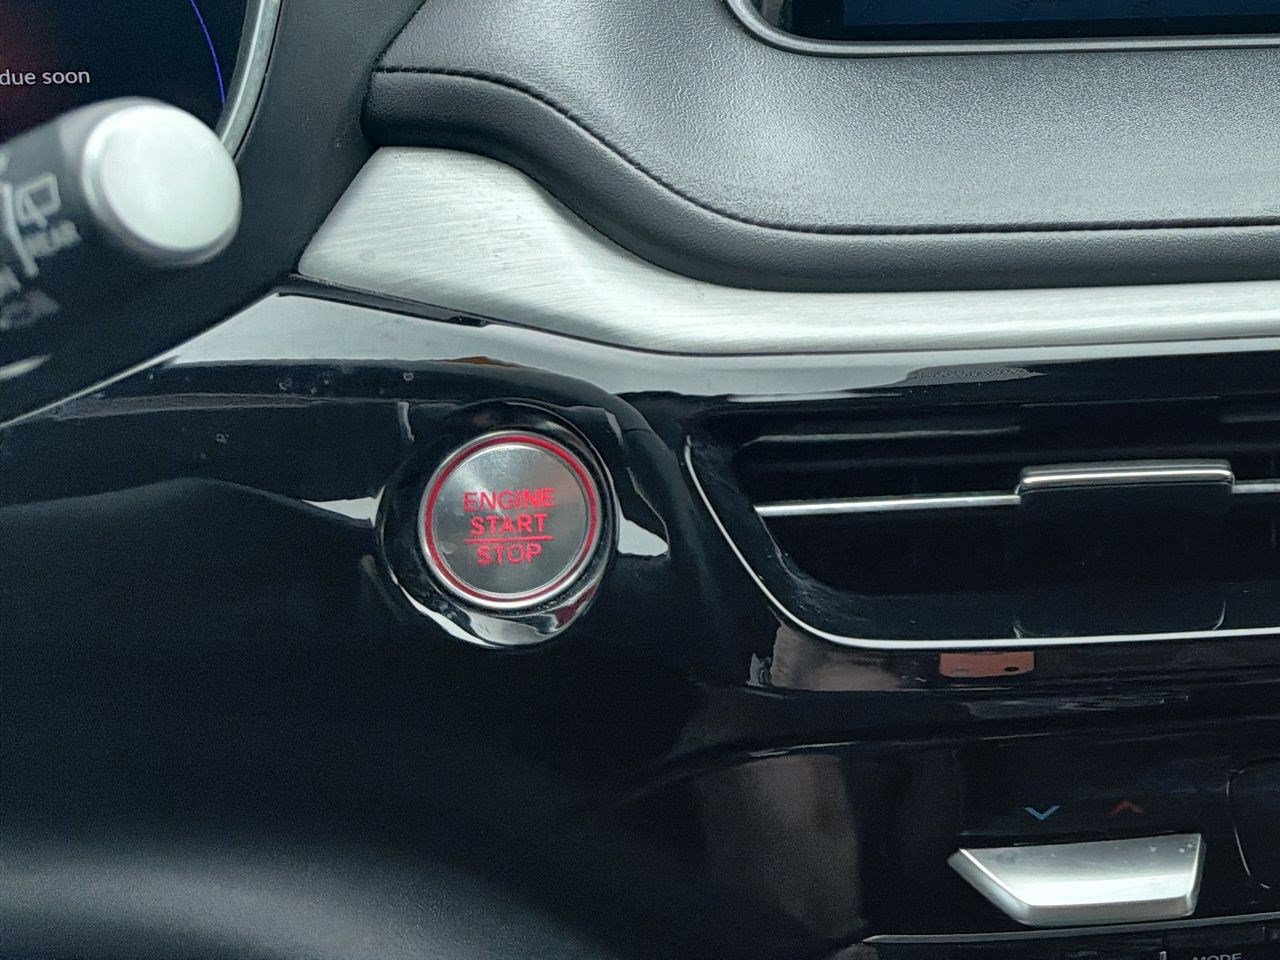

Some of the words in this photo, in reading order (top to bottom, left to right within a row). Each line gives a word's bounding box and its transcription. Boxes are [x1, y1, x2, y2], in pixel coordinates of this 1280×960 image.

[0, 69, 36, 85] due
[42, 70, 91, 85] soon
[463, 488, 555, 511] ENGINE
[470, 513, 548, 537] START
[477, 543, 543, 565] STOP
